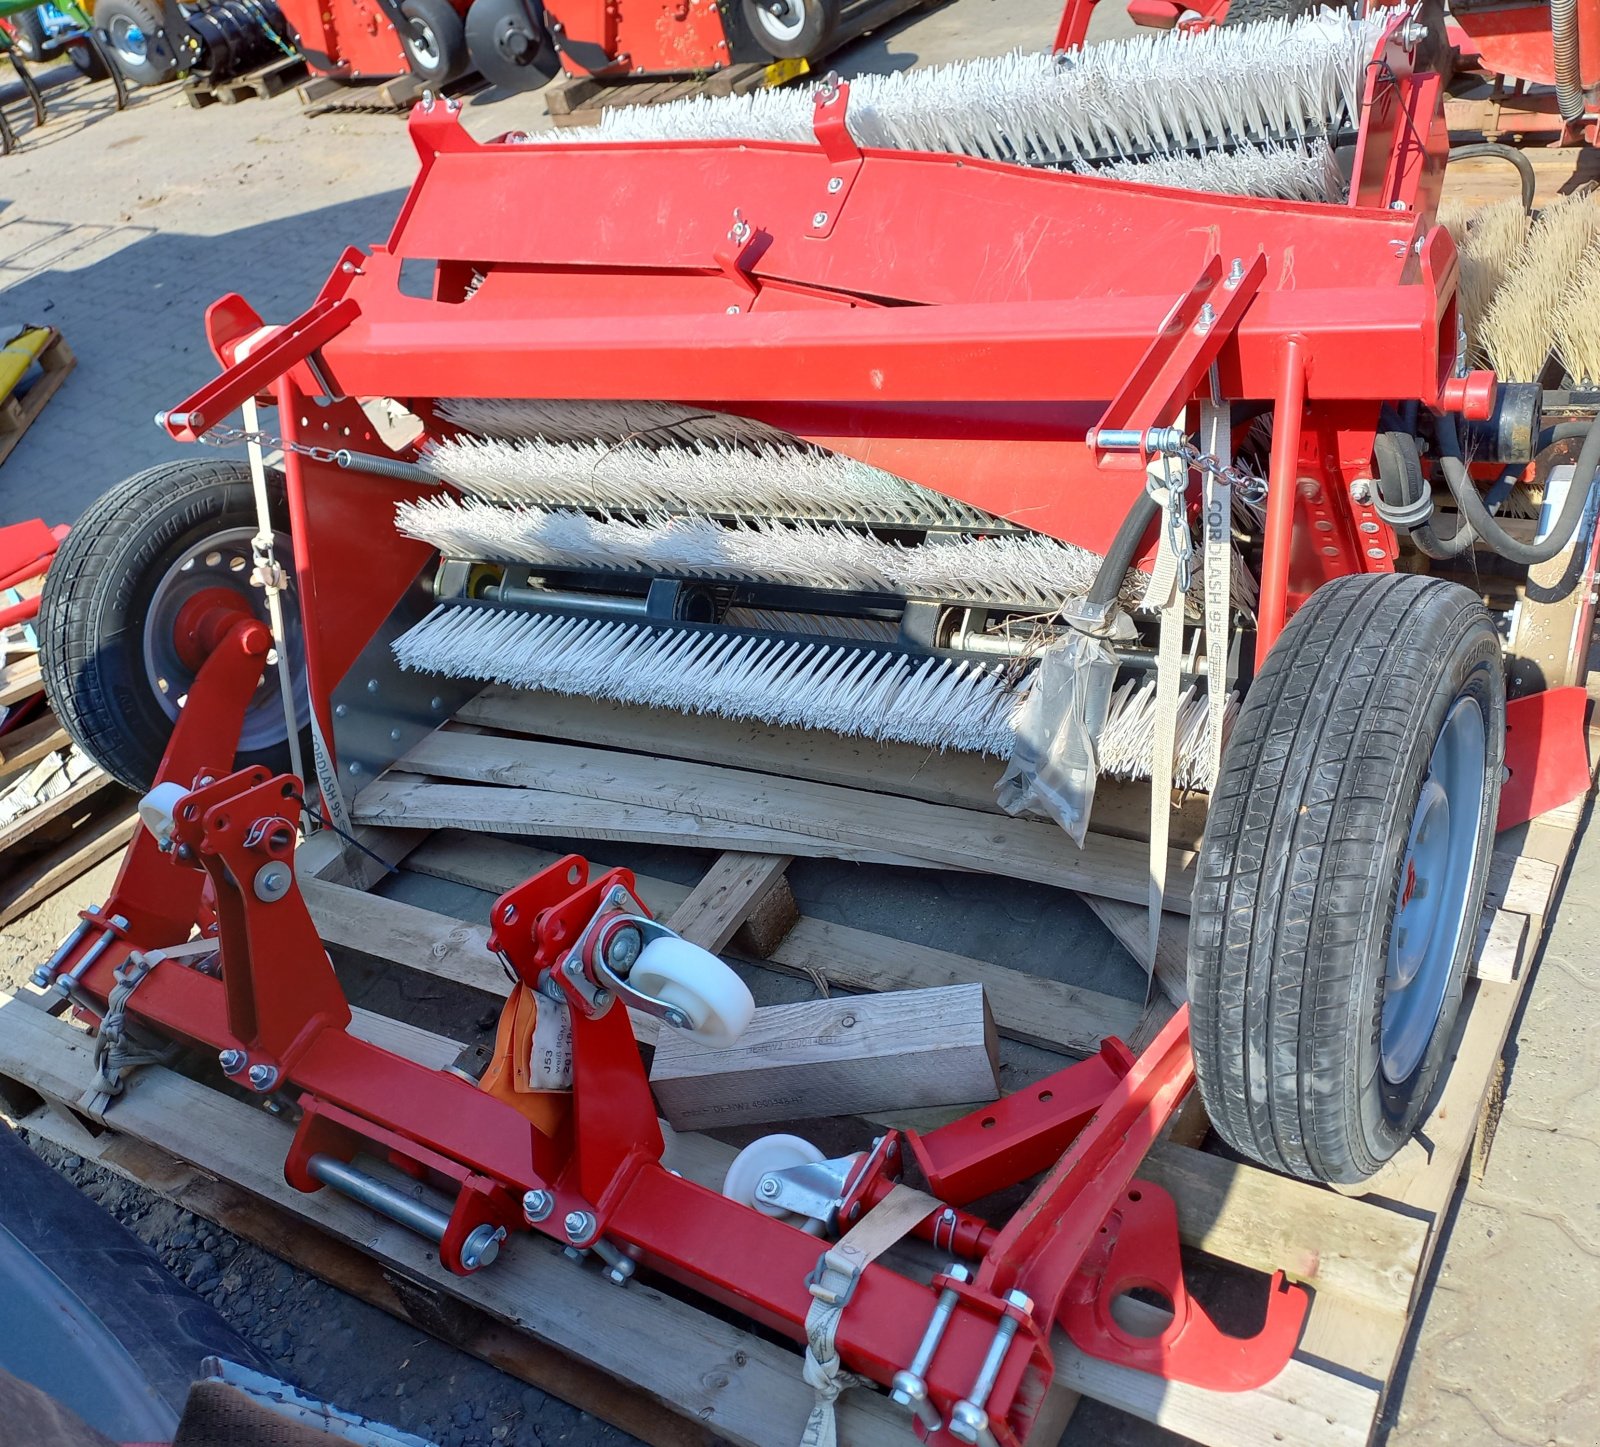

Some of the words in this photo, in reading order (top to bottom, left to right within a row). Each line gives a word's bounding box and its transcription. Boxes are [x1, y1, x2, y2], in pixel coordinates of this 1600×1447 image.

[1207, 501, 1222, 605] CORDLASH
[1209, 611, 1221, 633] 95
[331, 801, 342, 818] 95
[543, 1050, 553, 1074] J53
